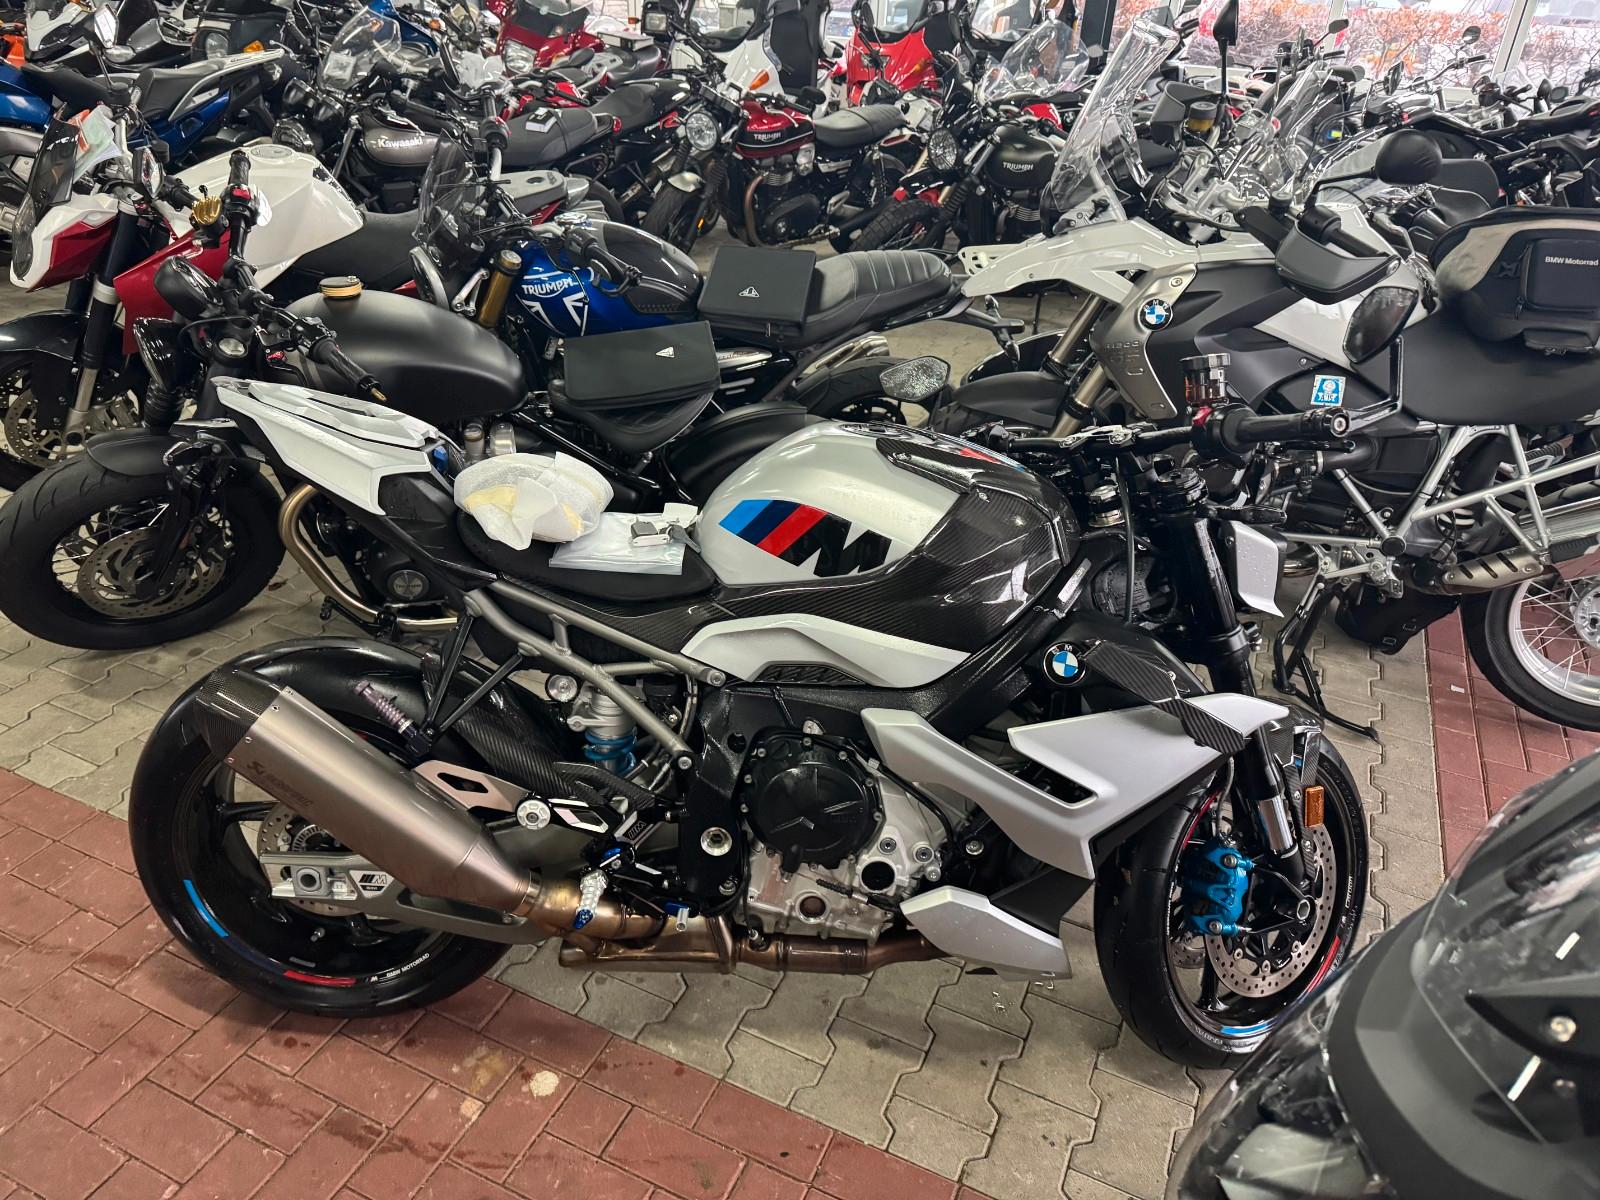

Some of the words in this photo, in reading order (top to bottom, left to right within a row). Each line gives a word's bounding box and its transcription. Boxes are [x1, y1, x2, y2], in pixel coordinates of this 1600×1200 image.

[754, 132, 781, 142] TRIUMPH
[377, 137, 424, 149] Kawasaki
[1002, 161, 1034, 172] TRIUMPH
[1545, 256, 1564, 265] BMW
[1565, 257, 1599, 266] Motorrad
[521, 277, 574, 298] TRIUMPH
[401, 952, 430, 973] MOTORRAD
